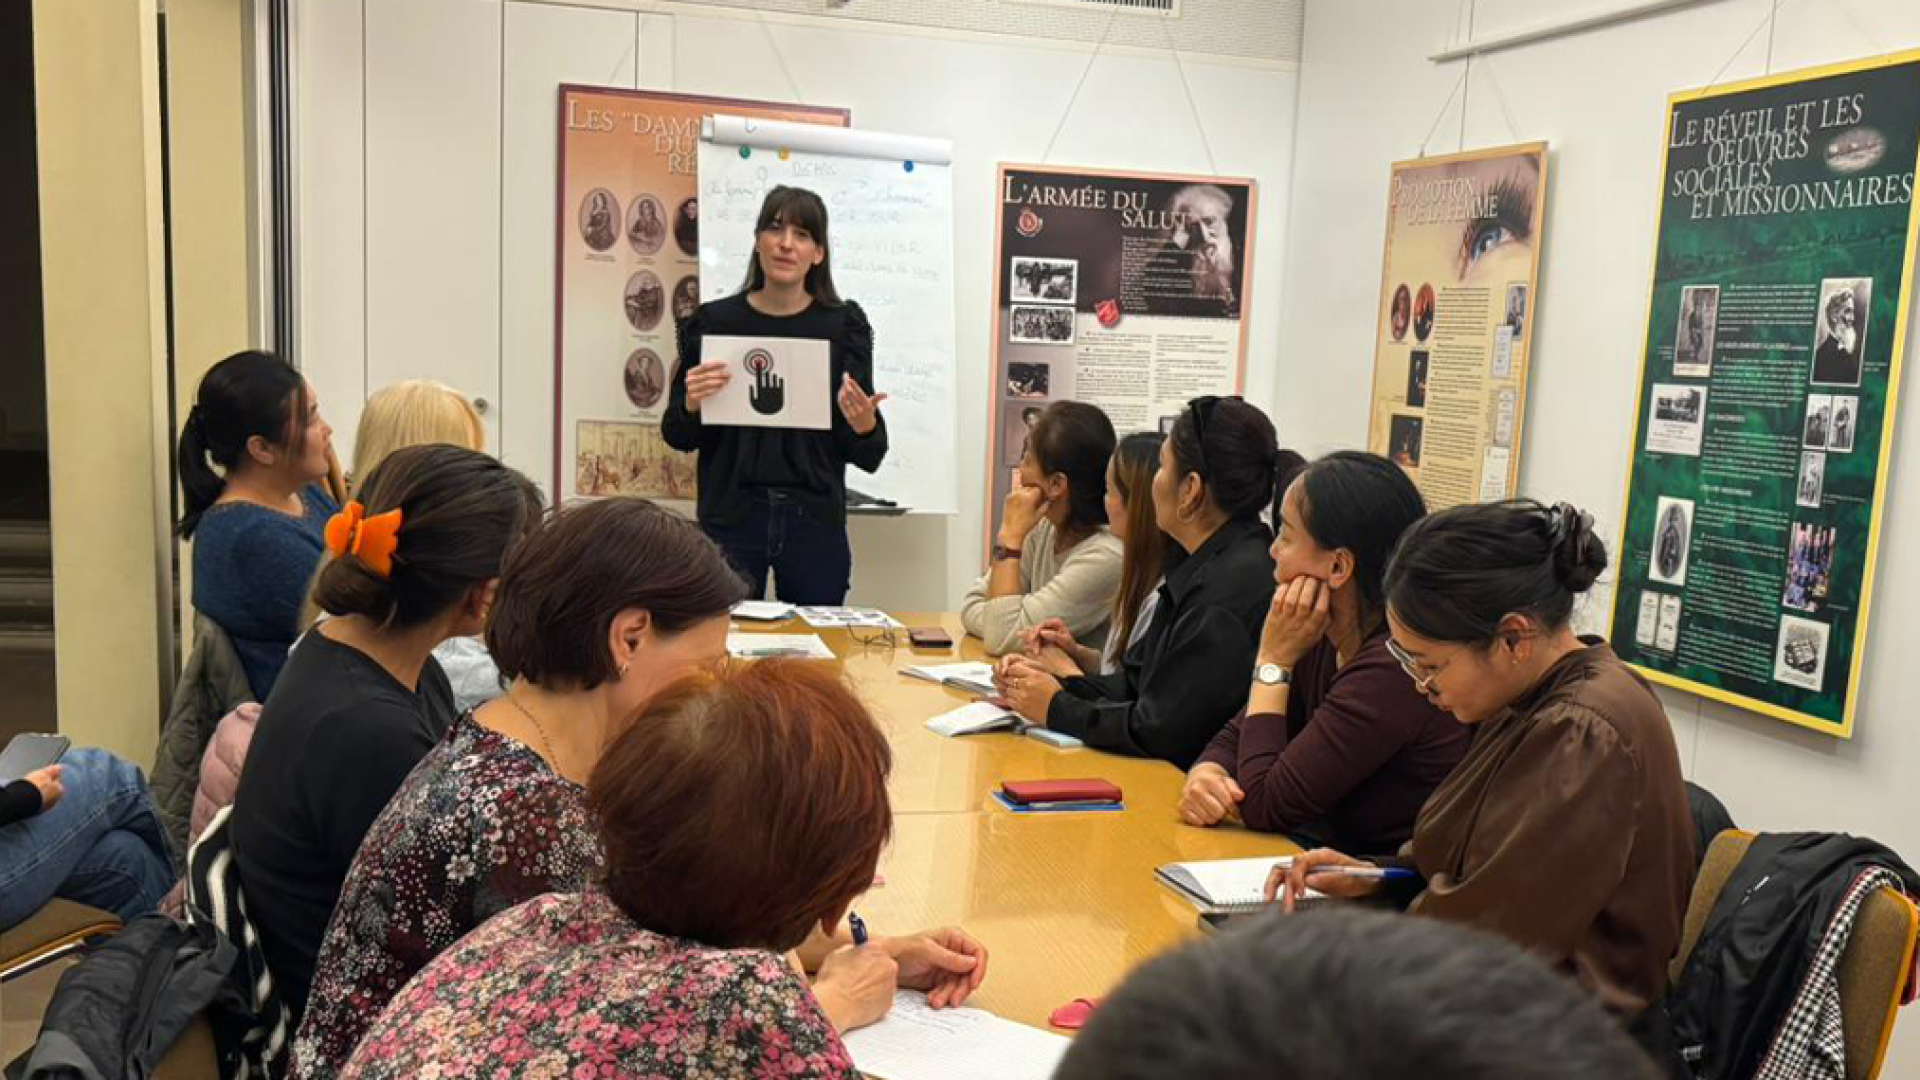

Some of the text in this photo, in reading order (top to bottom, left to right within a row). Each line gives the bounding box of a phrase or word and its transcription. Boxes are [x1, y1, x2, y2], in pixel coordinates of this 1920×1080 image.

[568, 99, 614, 132] LES
[1670, 93, 1864, 148] LE RÉVEIL ET LES
[1708, 128, 1809, 168] OEUVRES
[1003, 175, 1149, 211] L'ARMÉE DU
[1672, 162, 1773, 197] SOCIALES
[1691, 172, 1913, 219] ET MISSIONNAIRES
[1120, 209, 1188, 230] SALUT
